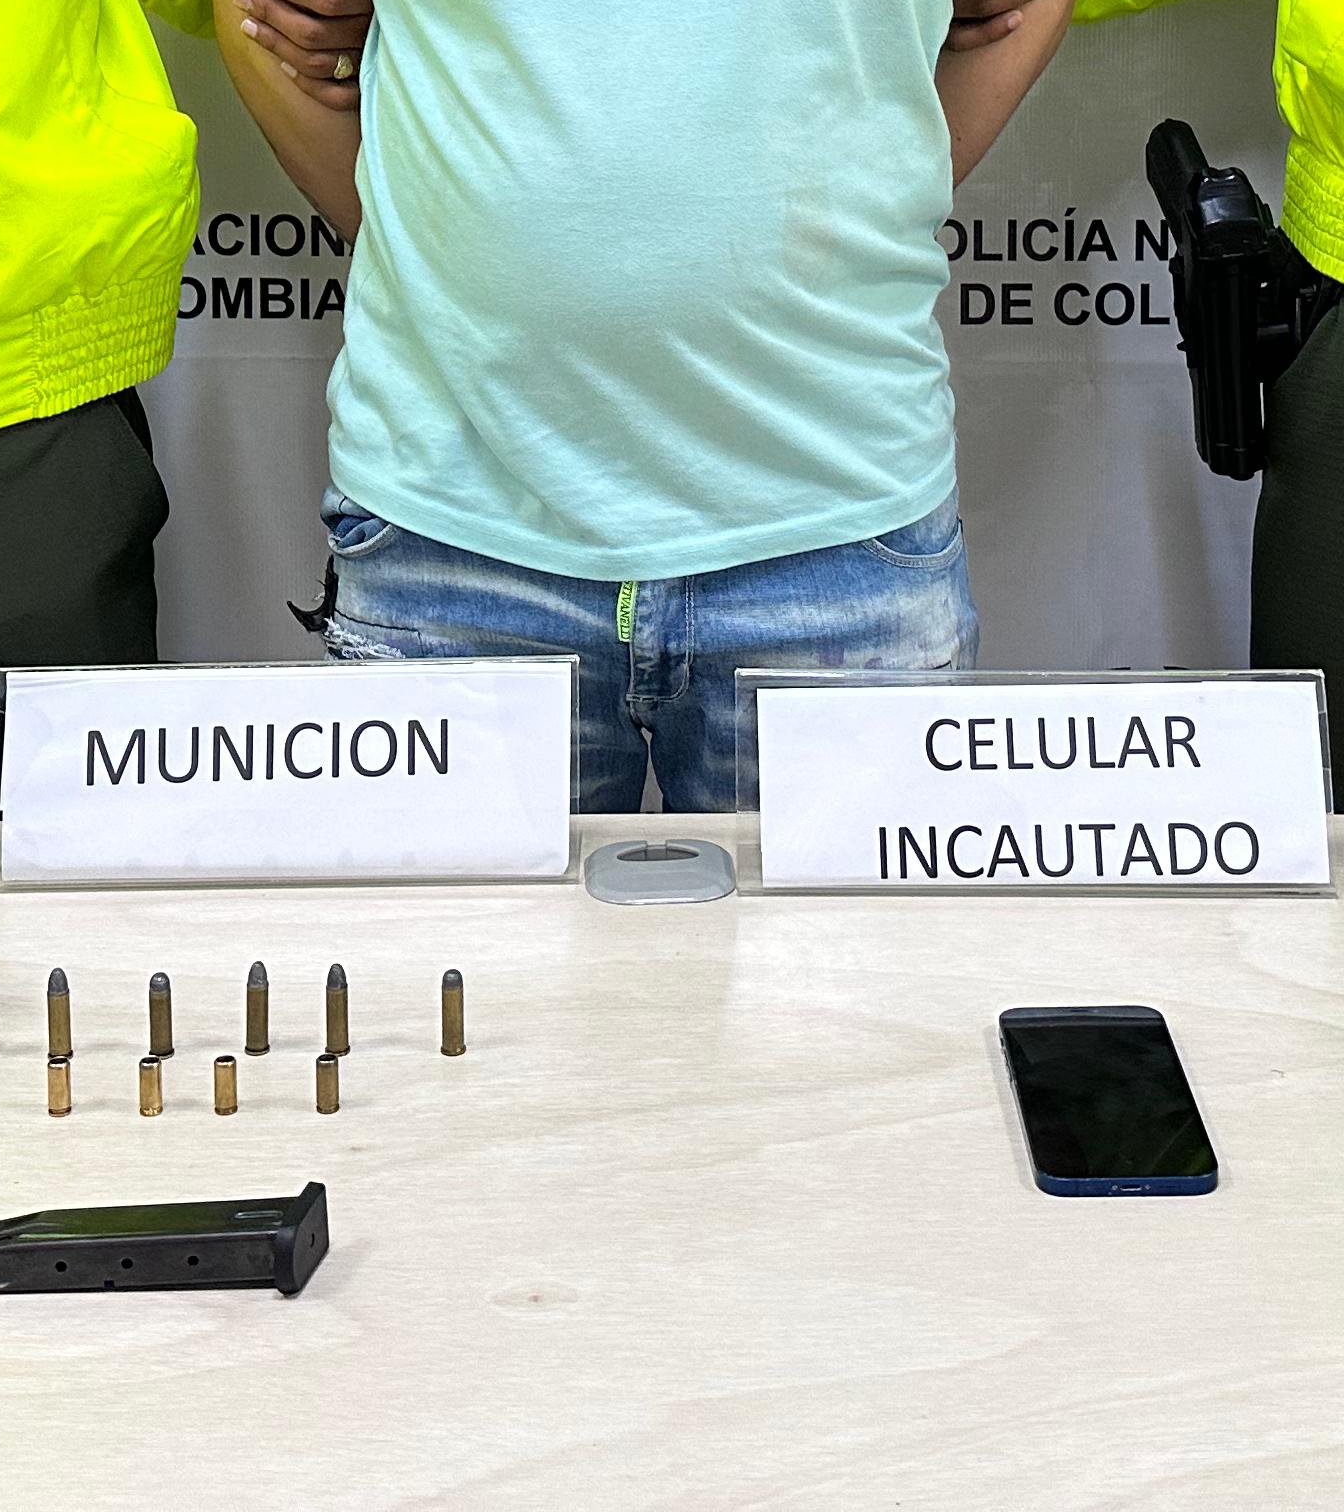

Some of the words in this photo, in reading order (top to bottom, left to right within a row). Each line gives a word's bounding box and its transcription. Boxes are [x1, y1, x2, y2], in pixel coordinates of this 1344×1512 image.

[942, 207, 1118, 262] OLICÍA
[177, 276, 346, 320] OMBIA
[960, 283, 1033, 325] DE
[86, 718, 450, 786] MUNICION
[925, 716, 1201, 773] CELULAR
[878, 821, 1260, 881] INCAUTADO
